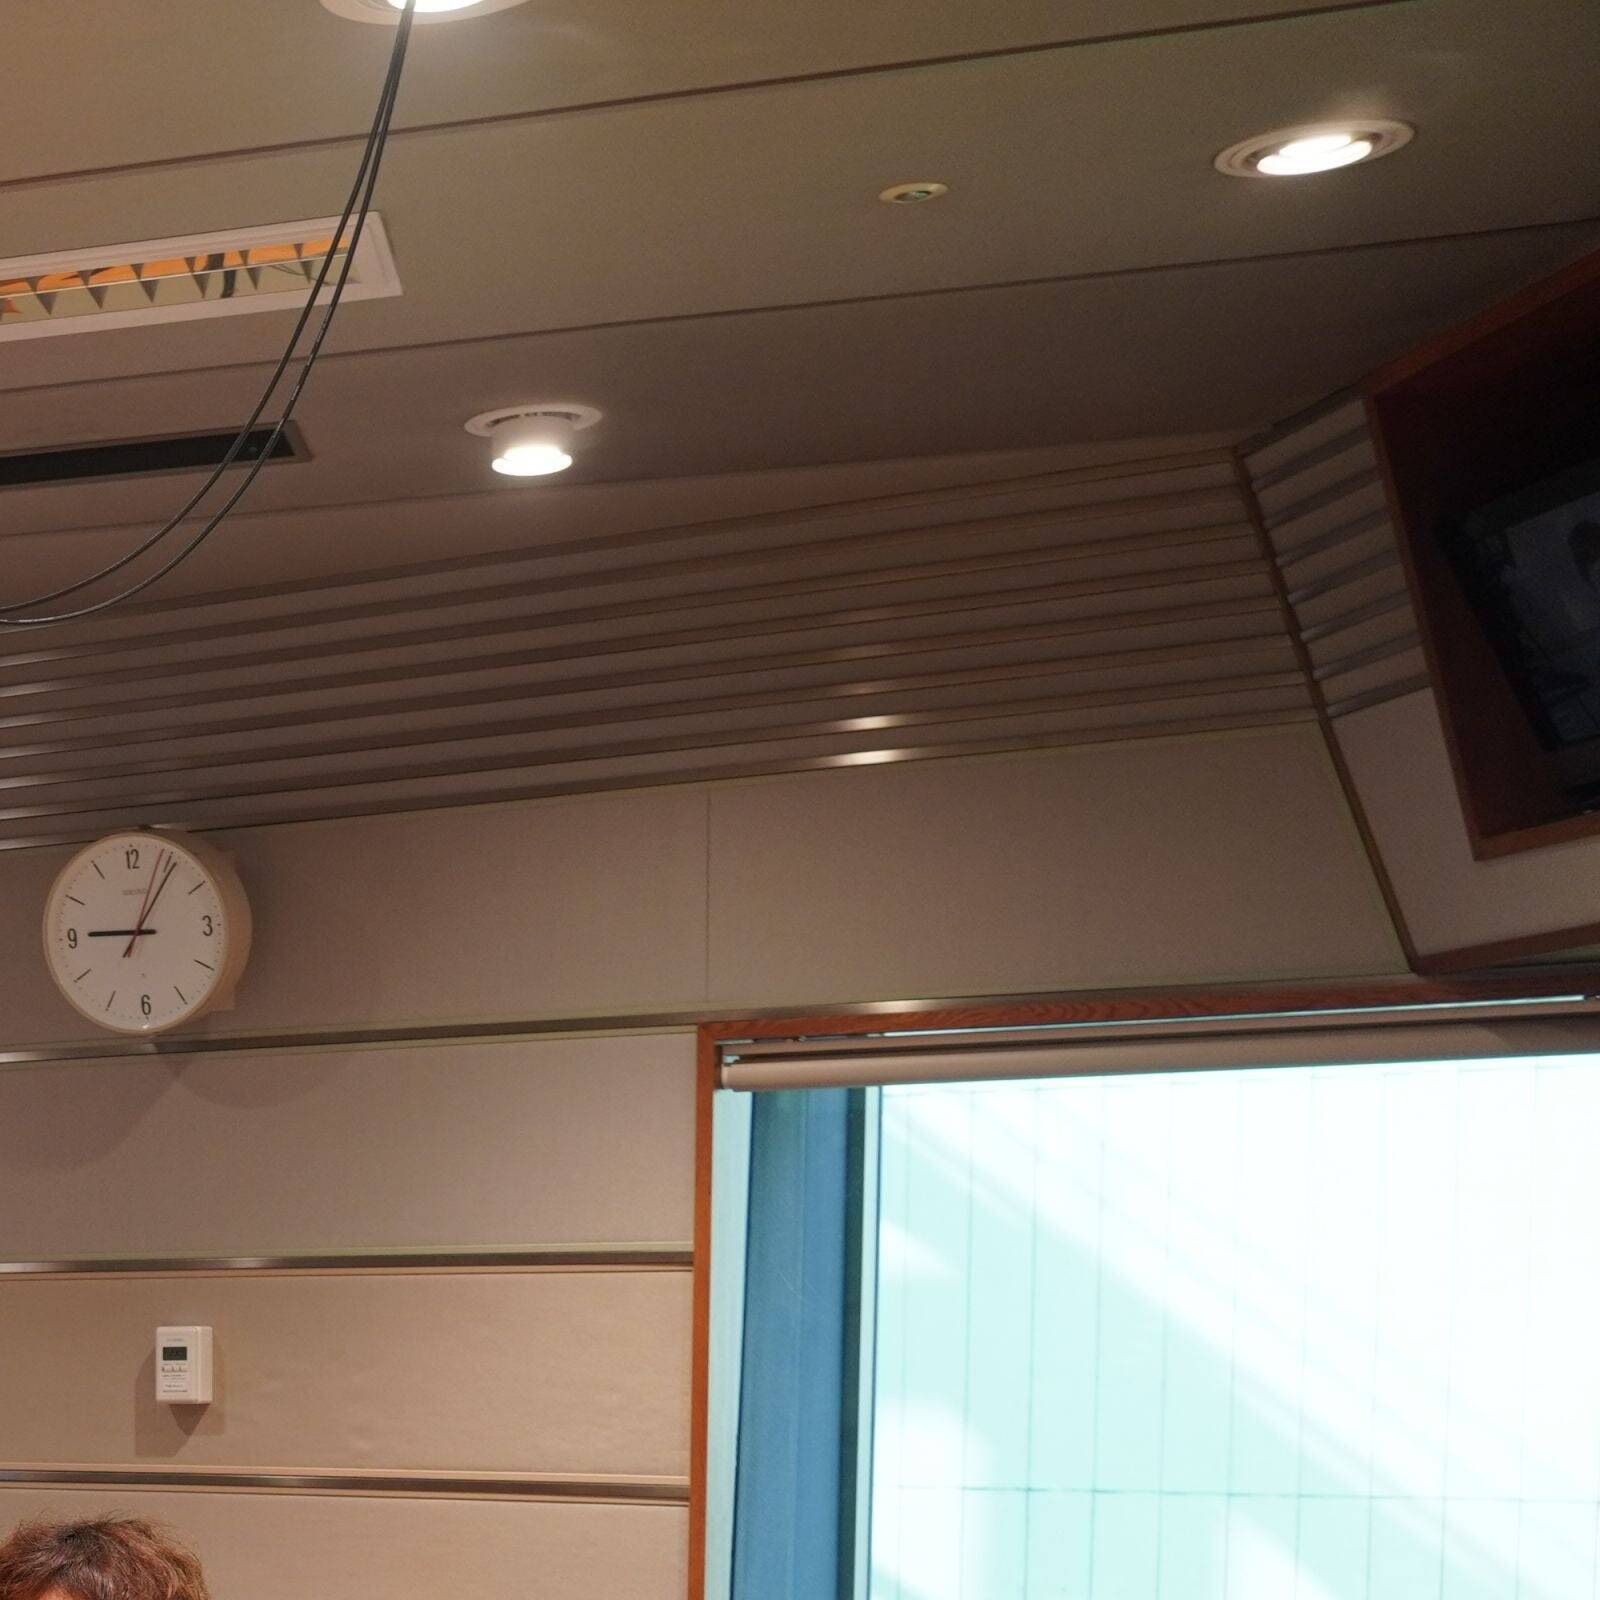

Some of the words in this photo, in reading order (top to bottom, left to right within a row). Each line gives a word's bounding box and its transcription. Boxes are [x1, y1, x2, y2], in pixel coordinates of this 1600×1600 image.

[125, 849, 140, 869] 12
[202, 915, 213, 936] 3
[67, 928, 78, 949] 9
[141, 994, 152, 1015] 6
